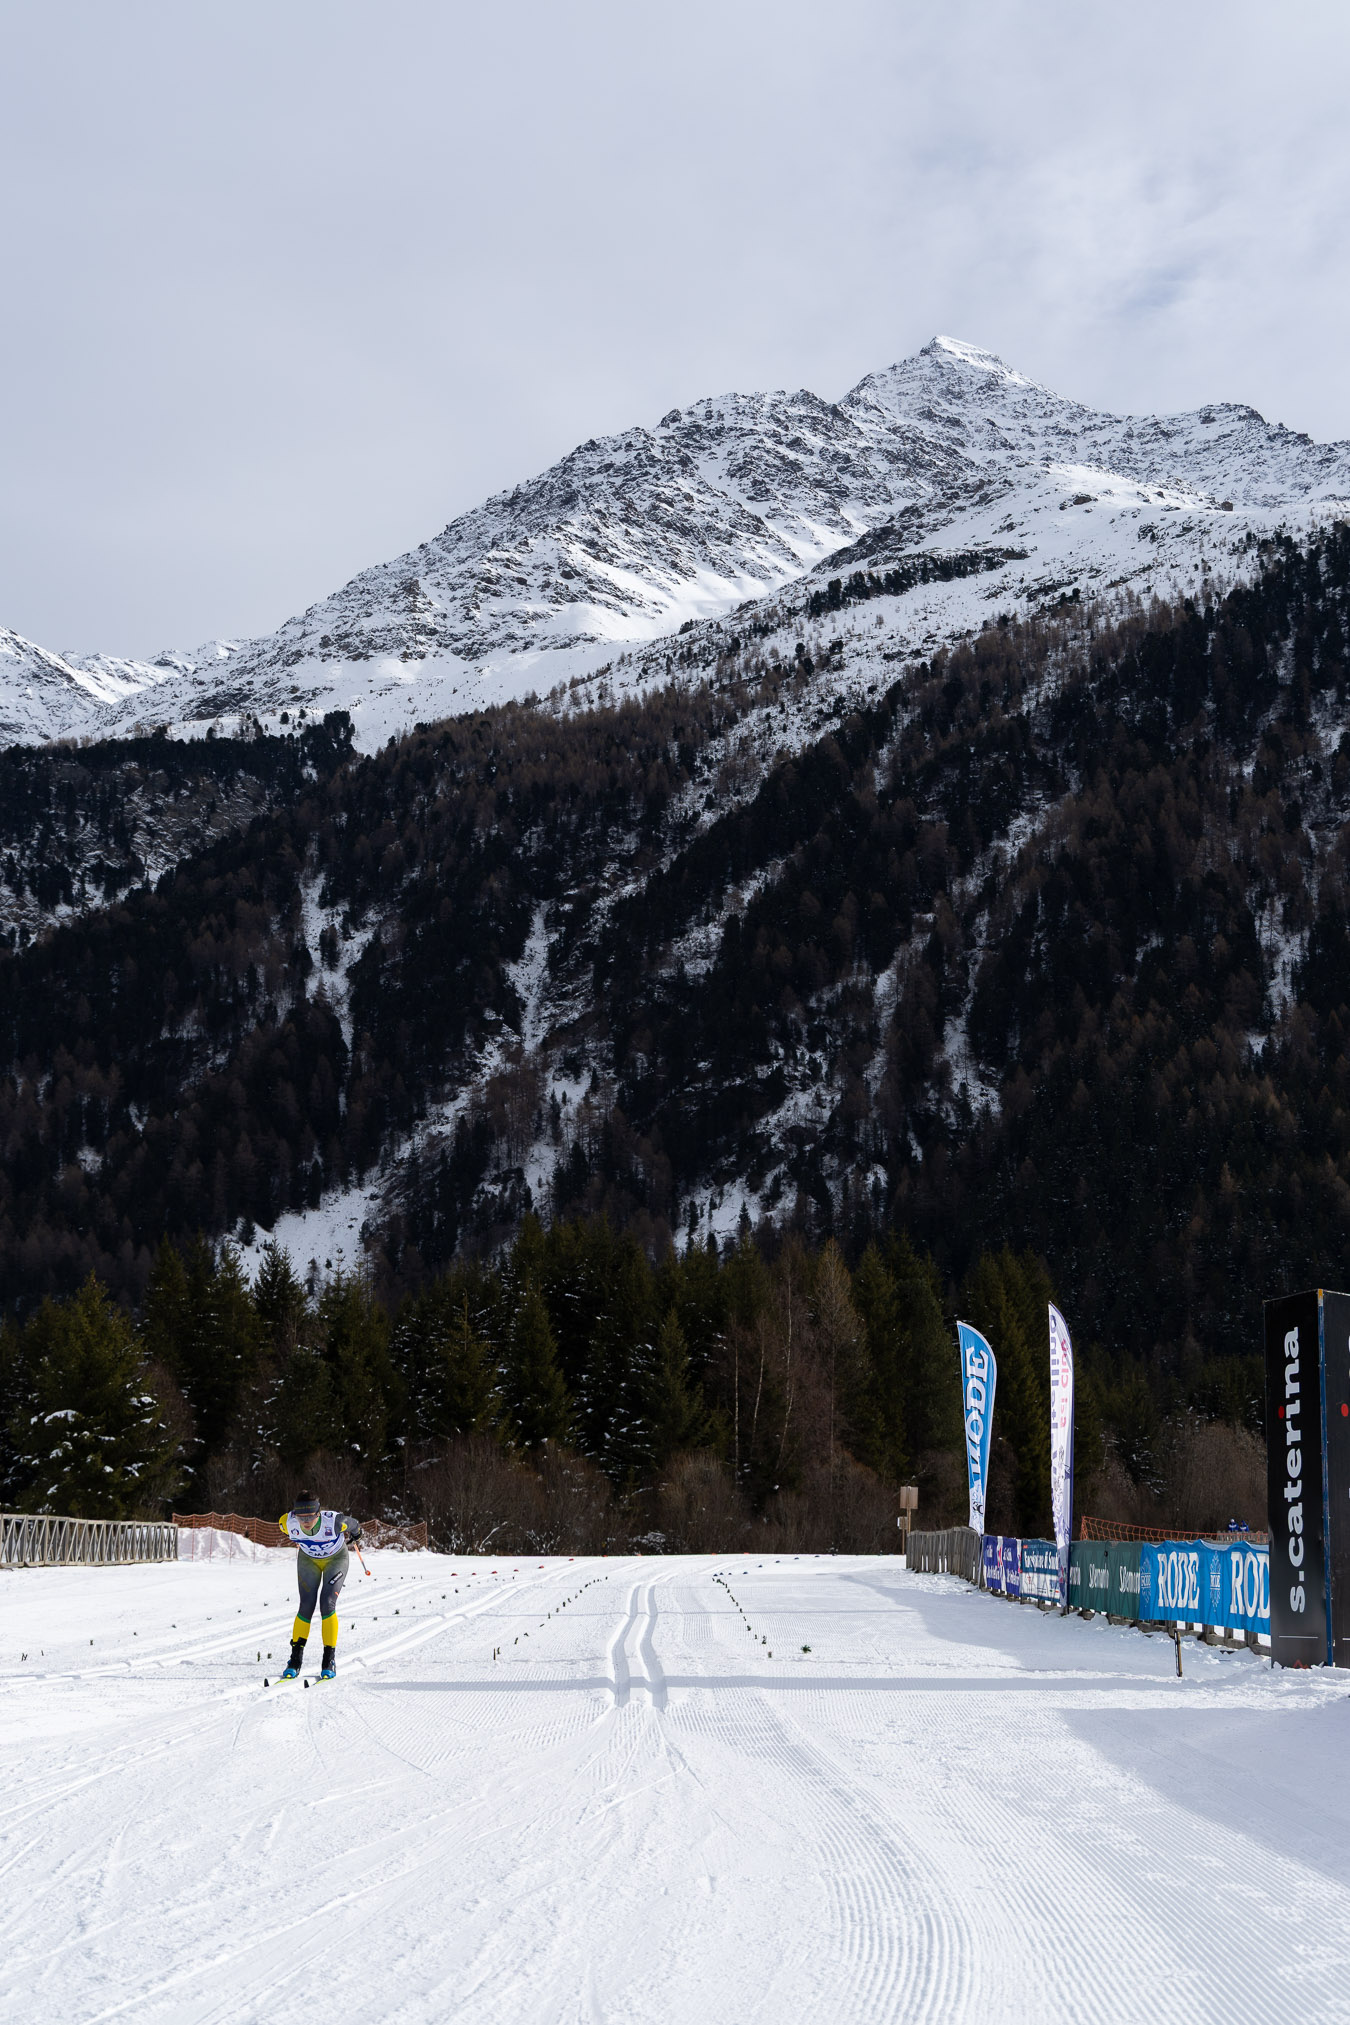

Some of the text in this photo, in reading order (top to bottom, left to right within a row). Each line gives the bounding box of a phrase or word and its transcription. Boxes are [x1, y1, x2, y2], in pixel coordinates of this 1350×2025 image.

[1278, 1326, 1305, 1613] s.caterina
[1157, 1551, 1200, 1609] RODE
[1229, 1551, 1270, 1619] ROD
